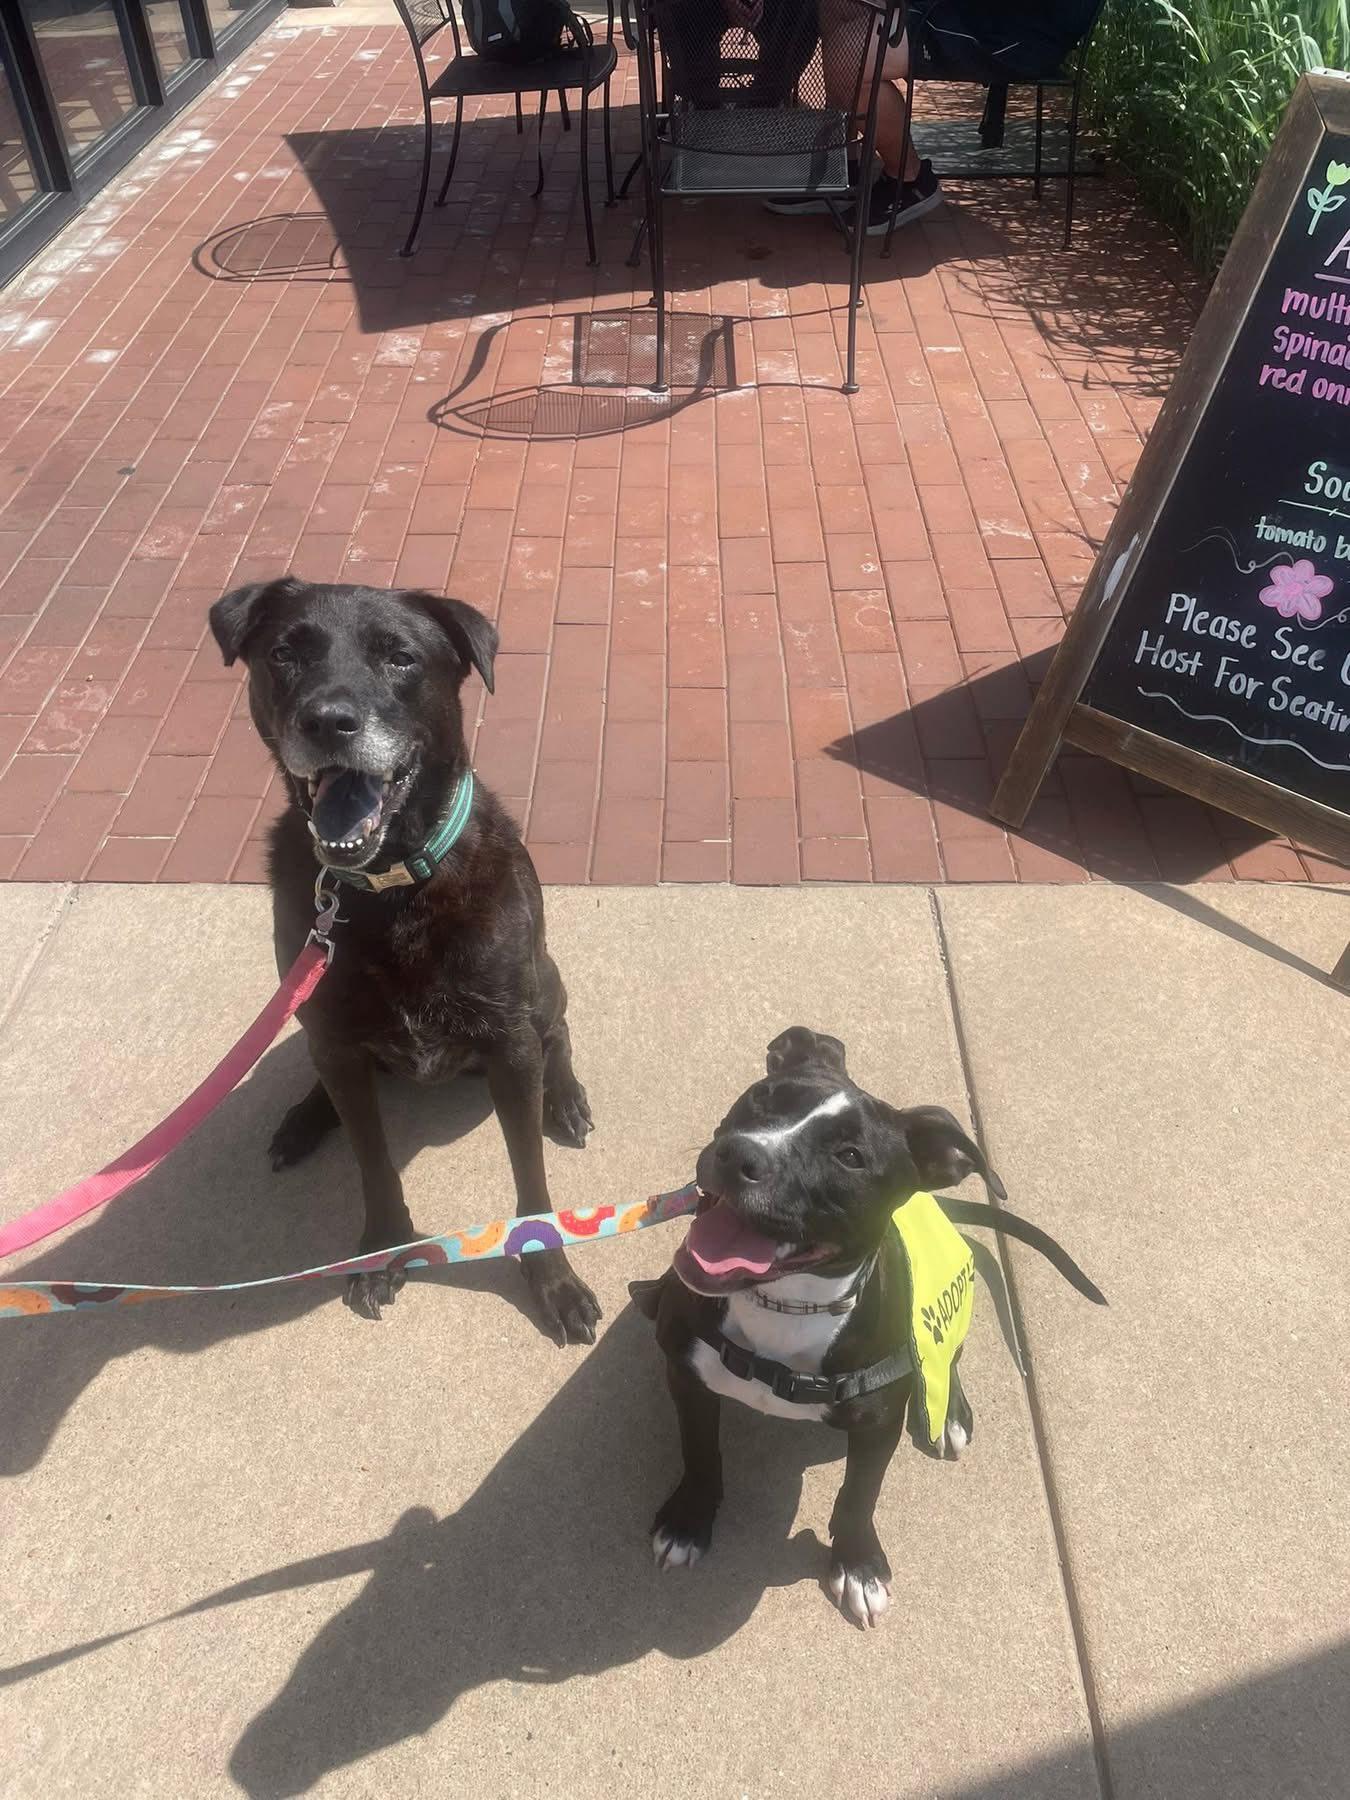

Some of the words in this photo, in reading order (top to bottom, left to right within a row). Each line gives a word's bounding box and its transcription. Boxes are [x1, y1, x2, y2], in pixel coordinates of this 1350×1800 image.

[1259, 364, 1307, 395] red
[1254, 515, 1327, 553] tomato
[1165, 592, 1257, 649] Please
[1270, 626, 1326, 672] See
[1134, 630, 1204, 677] Host
[1214, 656, 1264, 700] For
